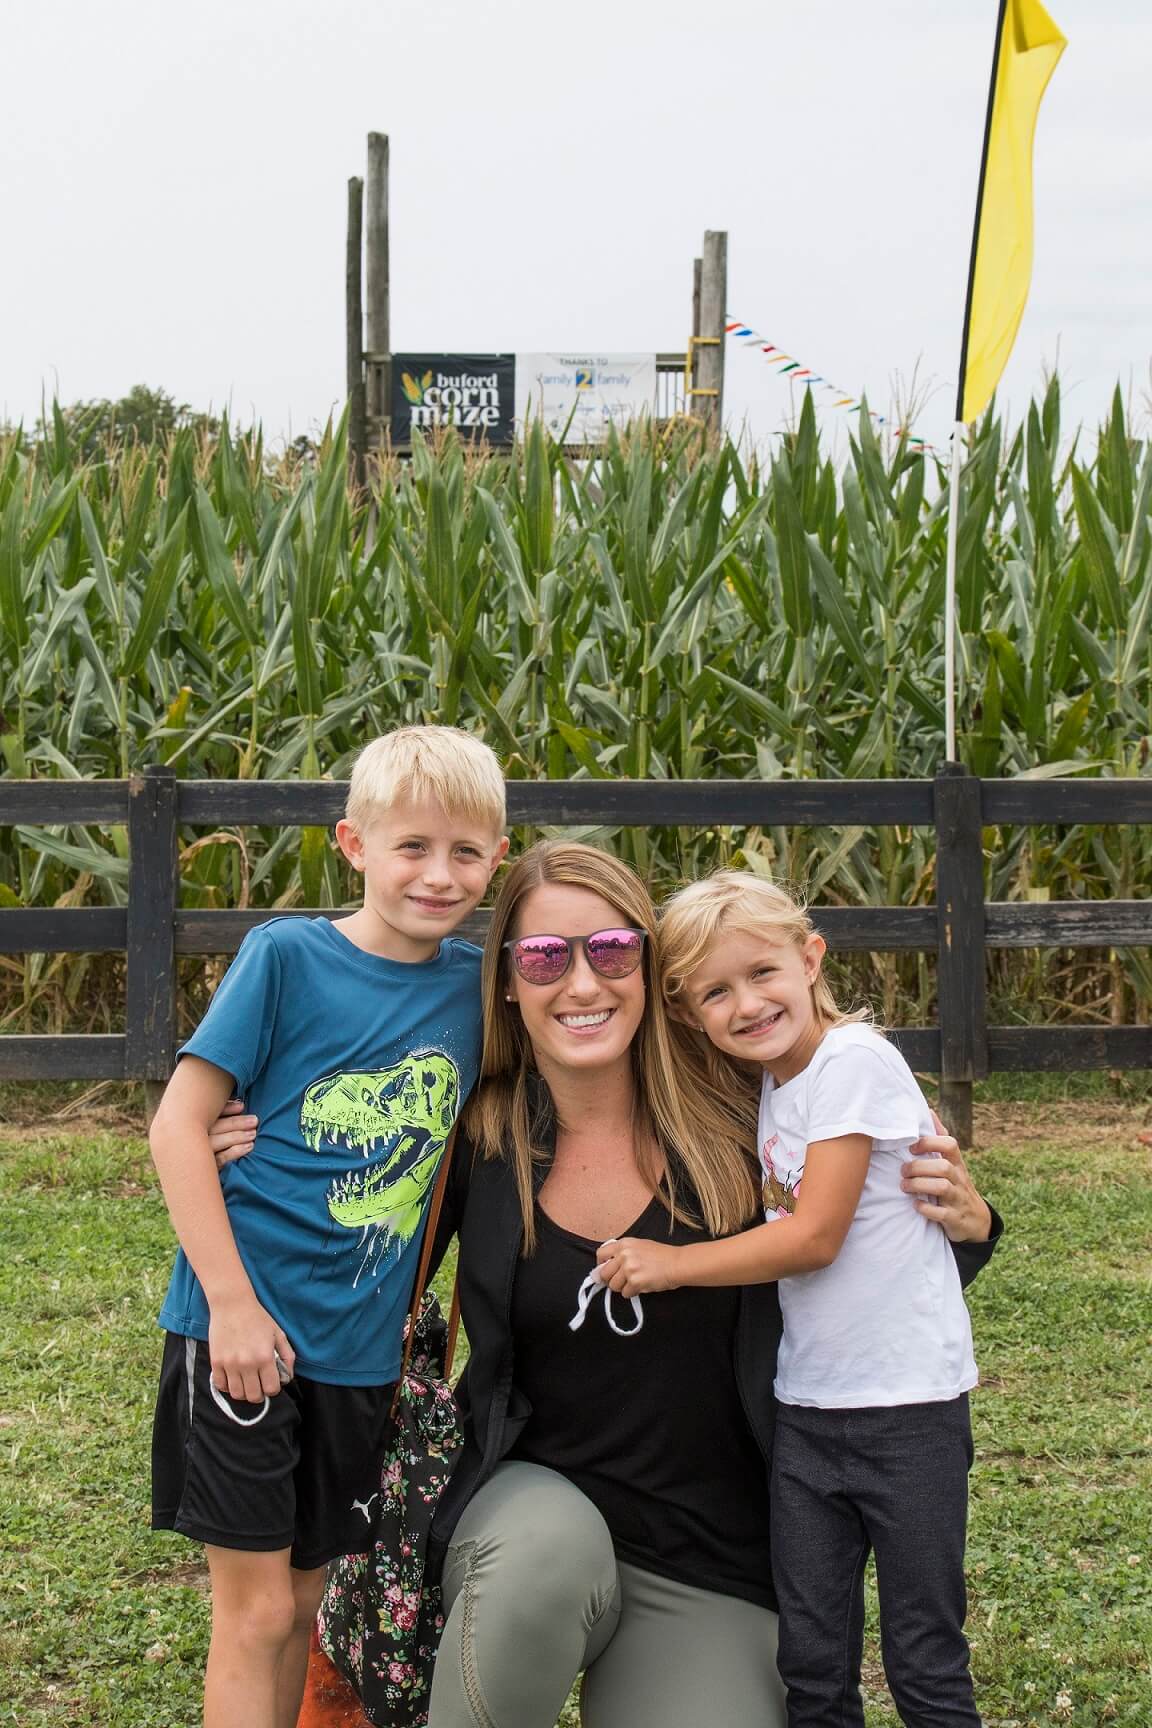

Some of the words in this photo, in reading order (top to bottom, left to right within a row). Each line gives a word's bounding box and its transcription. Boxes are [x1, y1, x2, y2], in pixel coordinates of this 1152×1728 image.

[559, 358, 594, 366] THANKS
[436, 372, 498, 388] buford
[579, 368, 593, 390] 2
[598, 372, 632, 386] family
[423, 386, 501, 407] corn
[409, 405, 501, 427] maze
